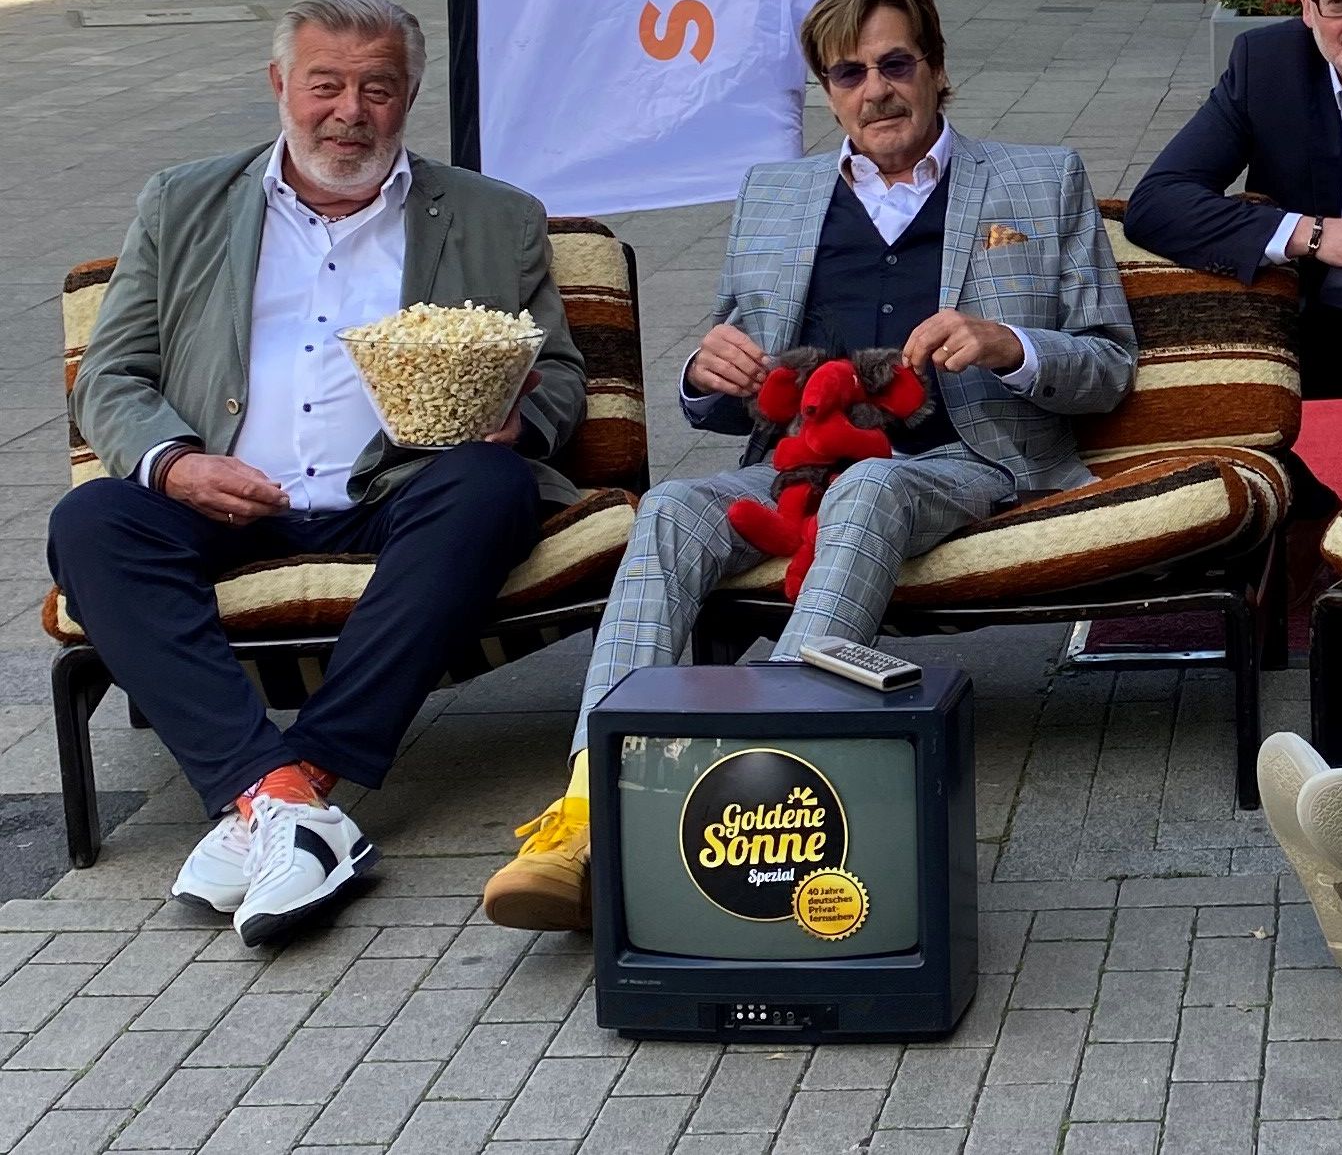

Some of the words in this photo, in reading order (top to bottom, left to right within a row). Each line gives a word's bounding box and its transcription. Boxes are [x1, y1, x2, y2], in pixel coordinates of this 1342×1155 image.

[722, 803, 826, 838] Goldene
[699, 823, 827, 869] Sonne
[747, 867, 795, 886] Spezial
[807, 887, 819, 896] 40
[820, 886, 845, 896] Jahre
[807, 895, 853, 906] deutsches
